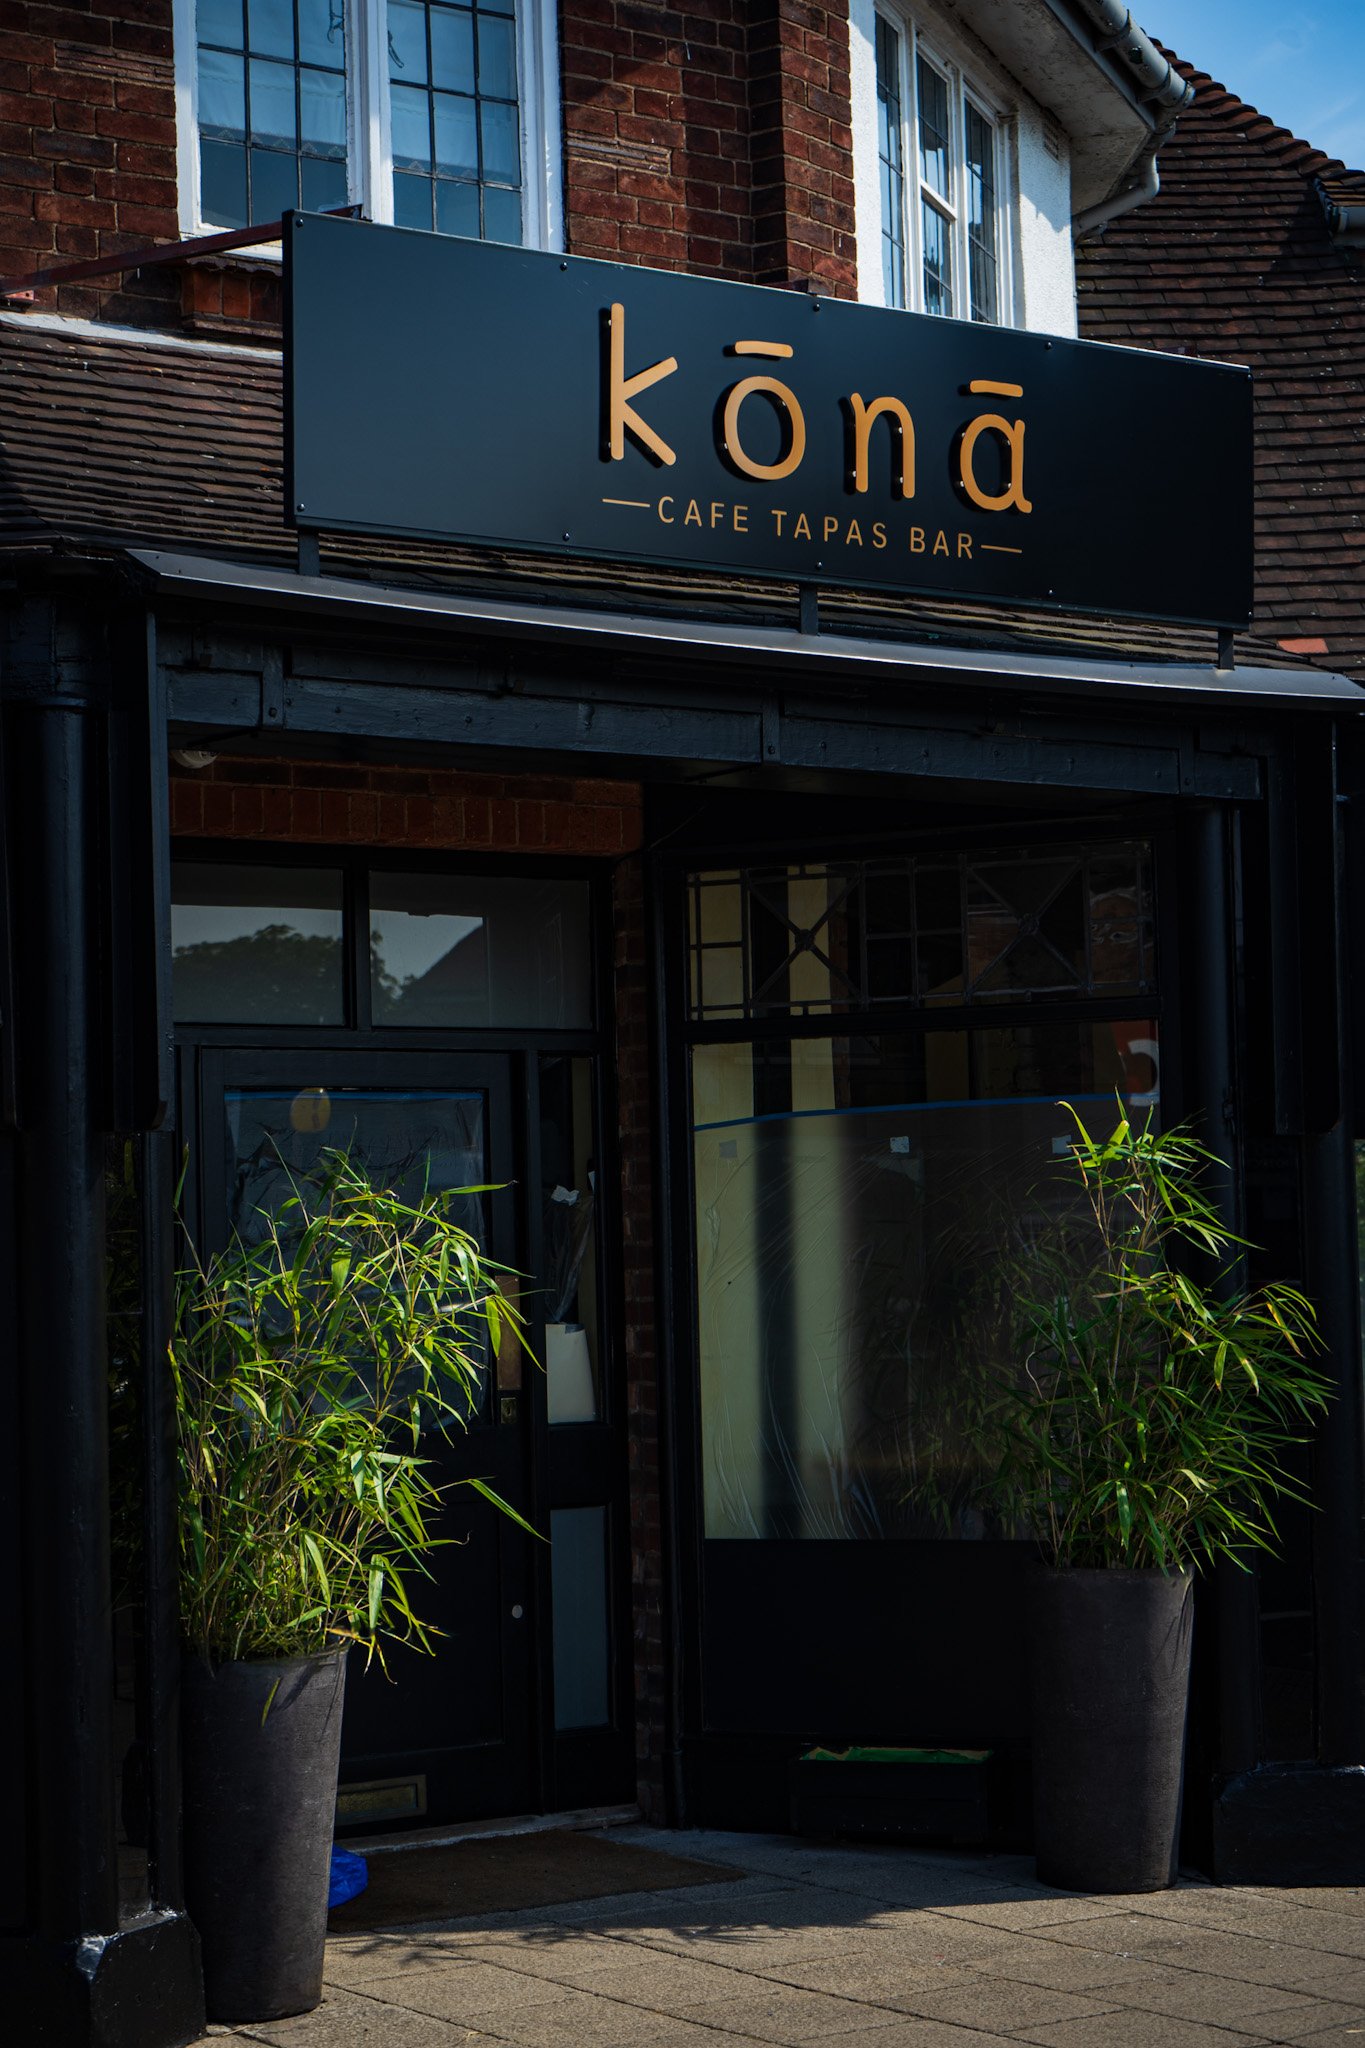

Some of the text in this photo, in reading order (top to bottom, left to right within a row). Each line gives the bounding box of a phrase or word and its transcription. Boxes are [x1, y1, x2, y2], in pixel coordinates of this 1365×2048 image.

[657, 495, 974, 559] CAFE TAPAS BAR
